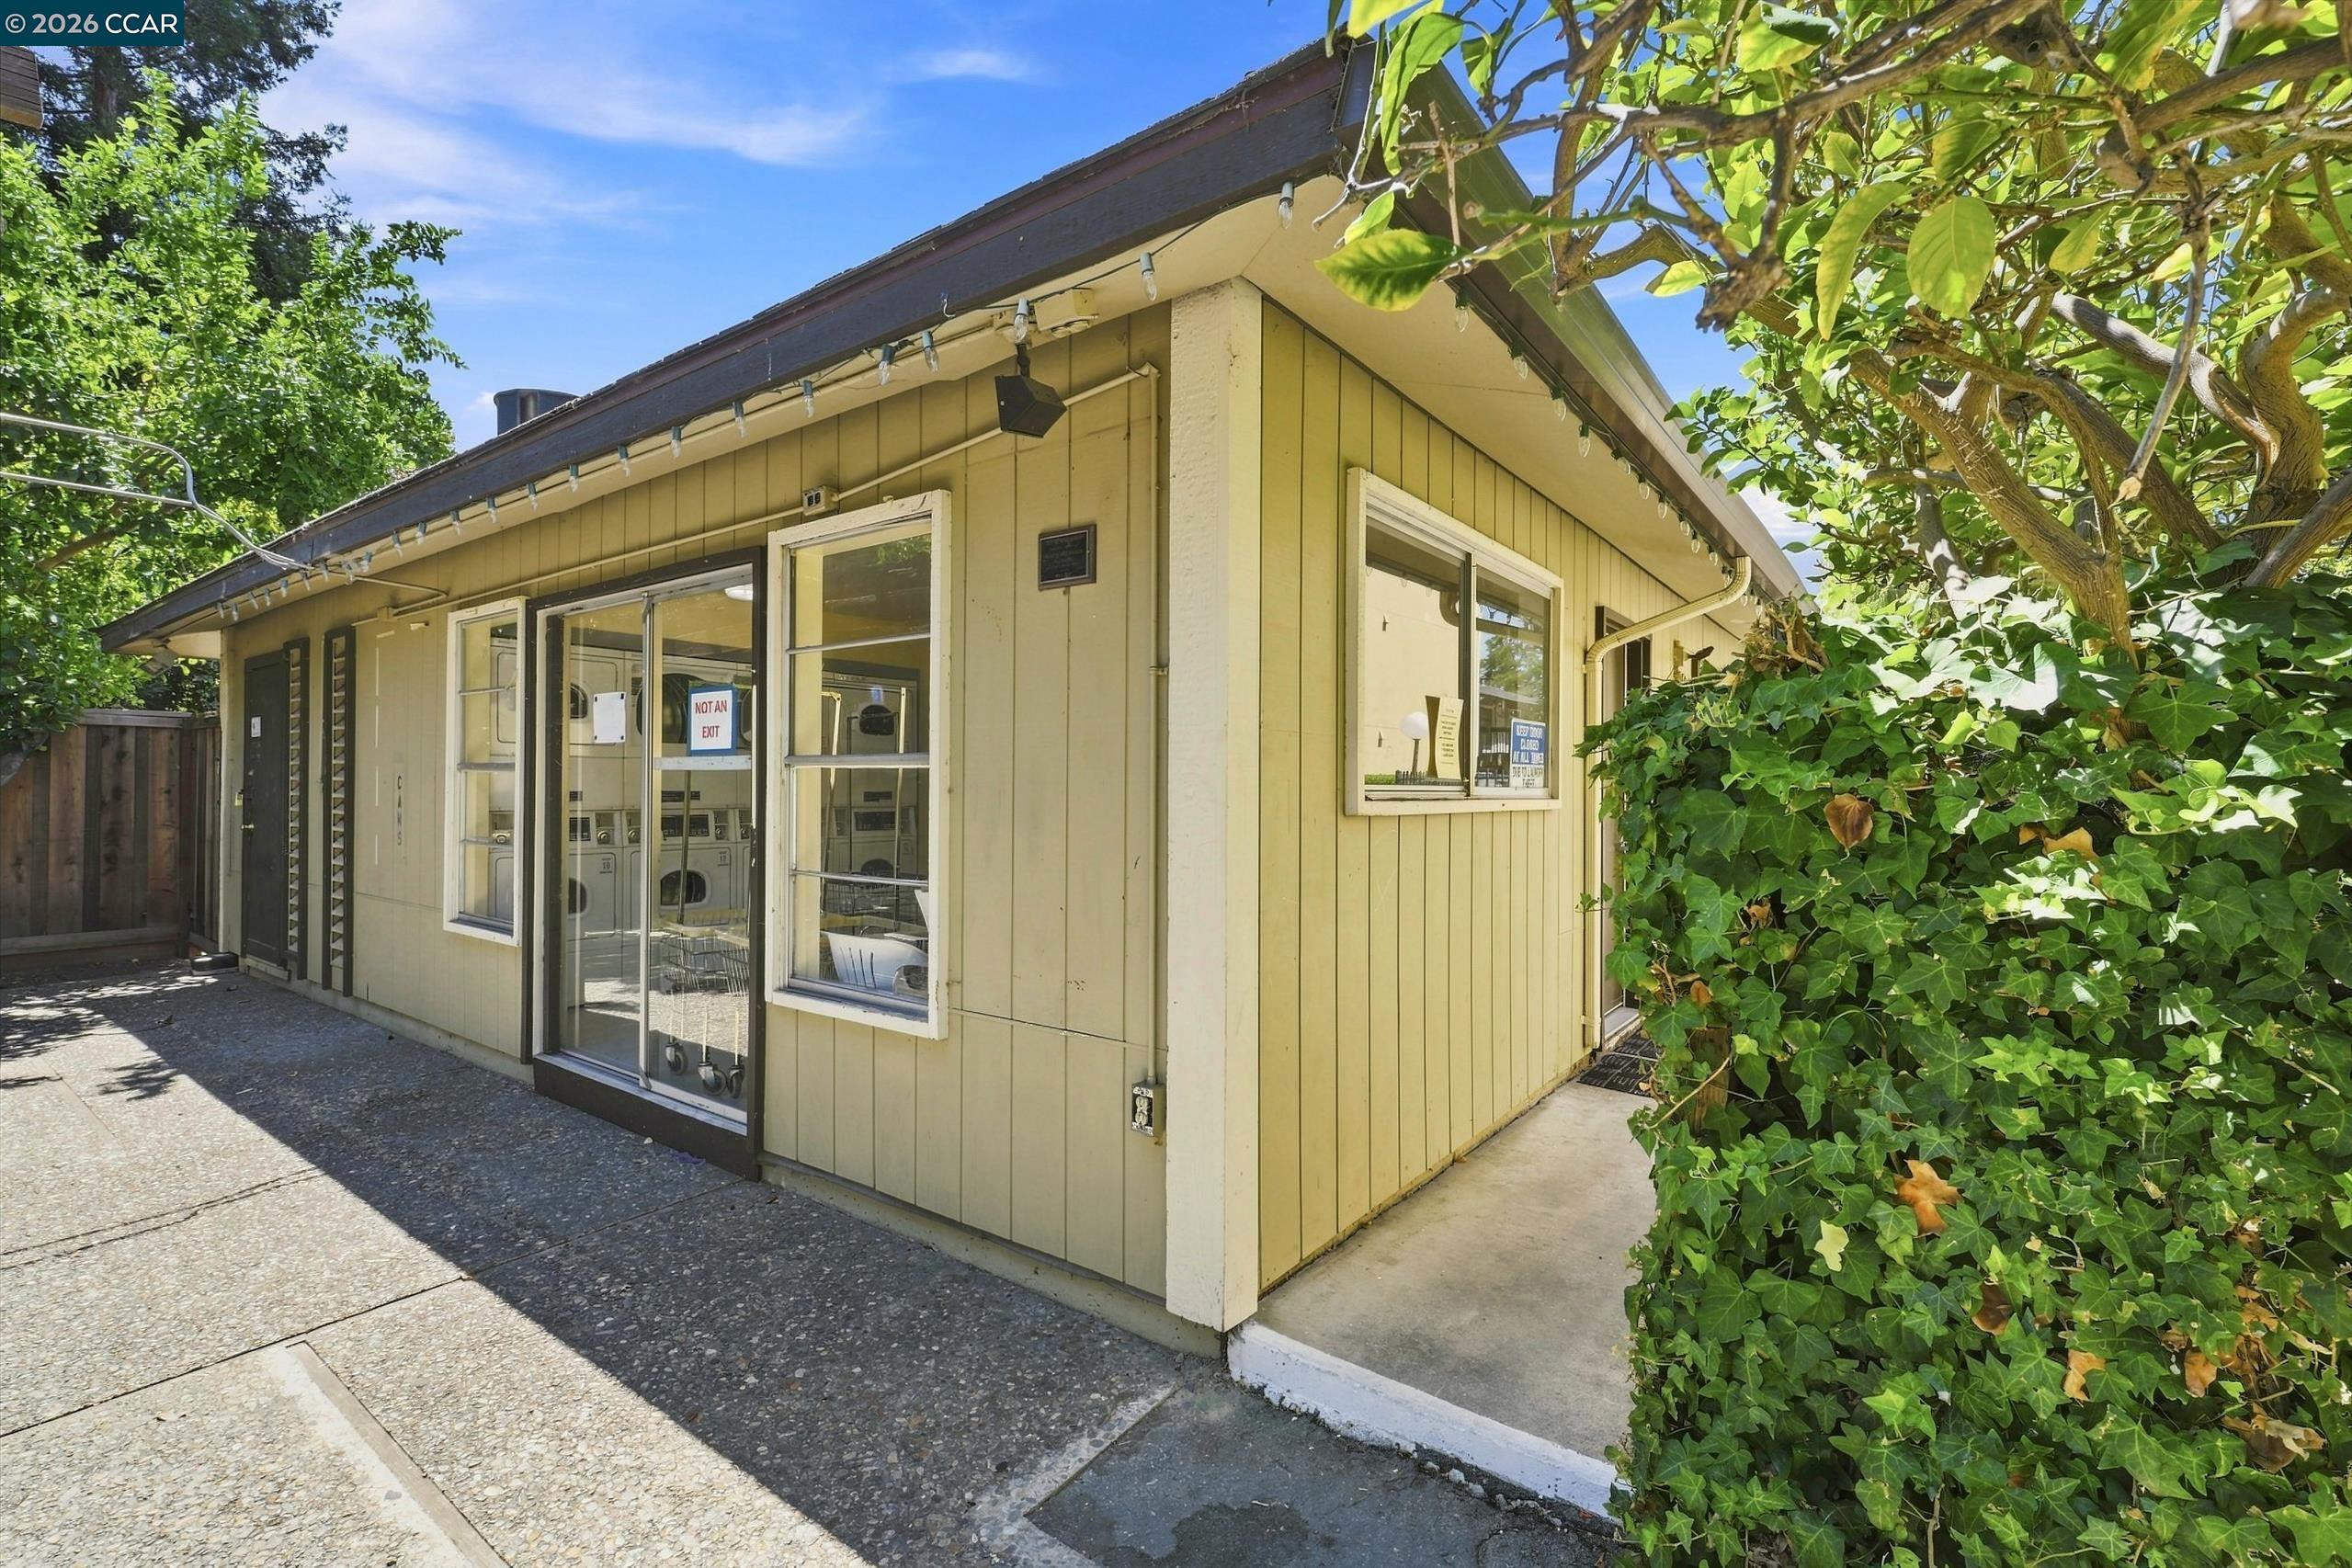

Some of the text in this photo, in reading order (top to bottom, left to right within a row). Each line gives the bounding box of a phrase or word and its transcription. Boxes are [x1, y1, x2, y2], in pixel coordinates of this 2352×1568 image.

[695, 699, 727, 714] NOT AN
[702, 725, 720, 739] EXIT
[1516, 724, 1543, 739] KEEP DOOR
[1520, 738, 1540, 751] CLOSED
[1512, 750, 1520, 763] AT
[1520, 751, 1529, 764] ALL
